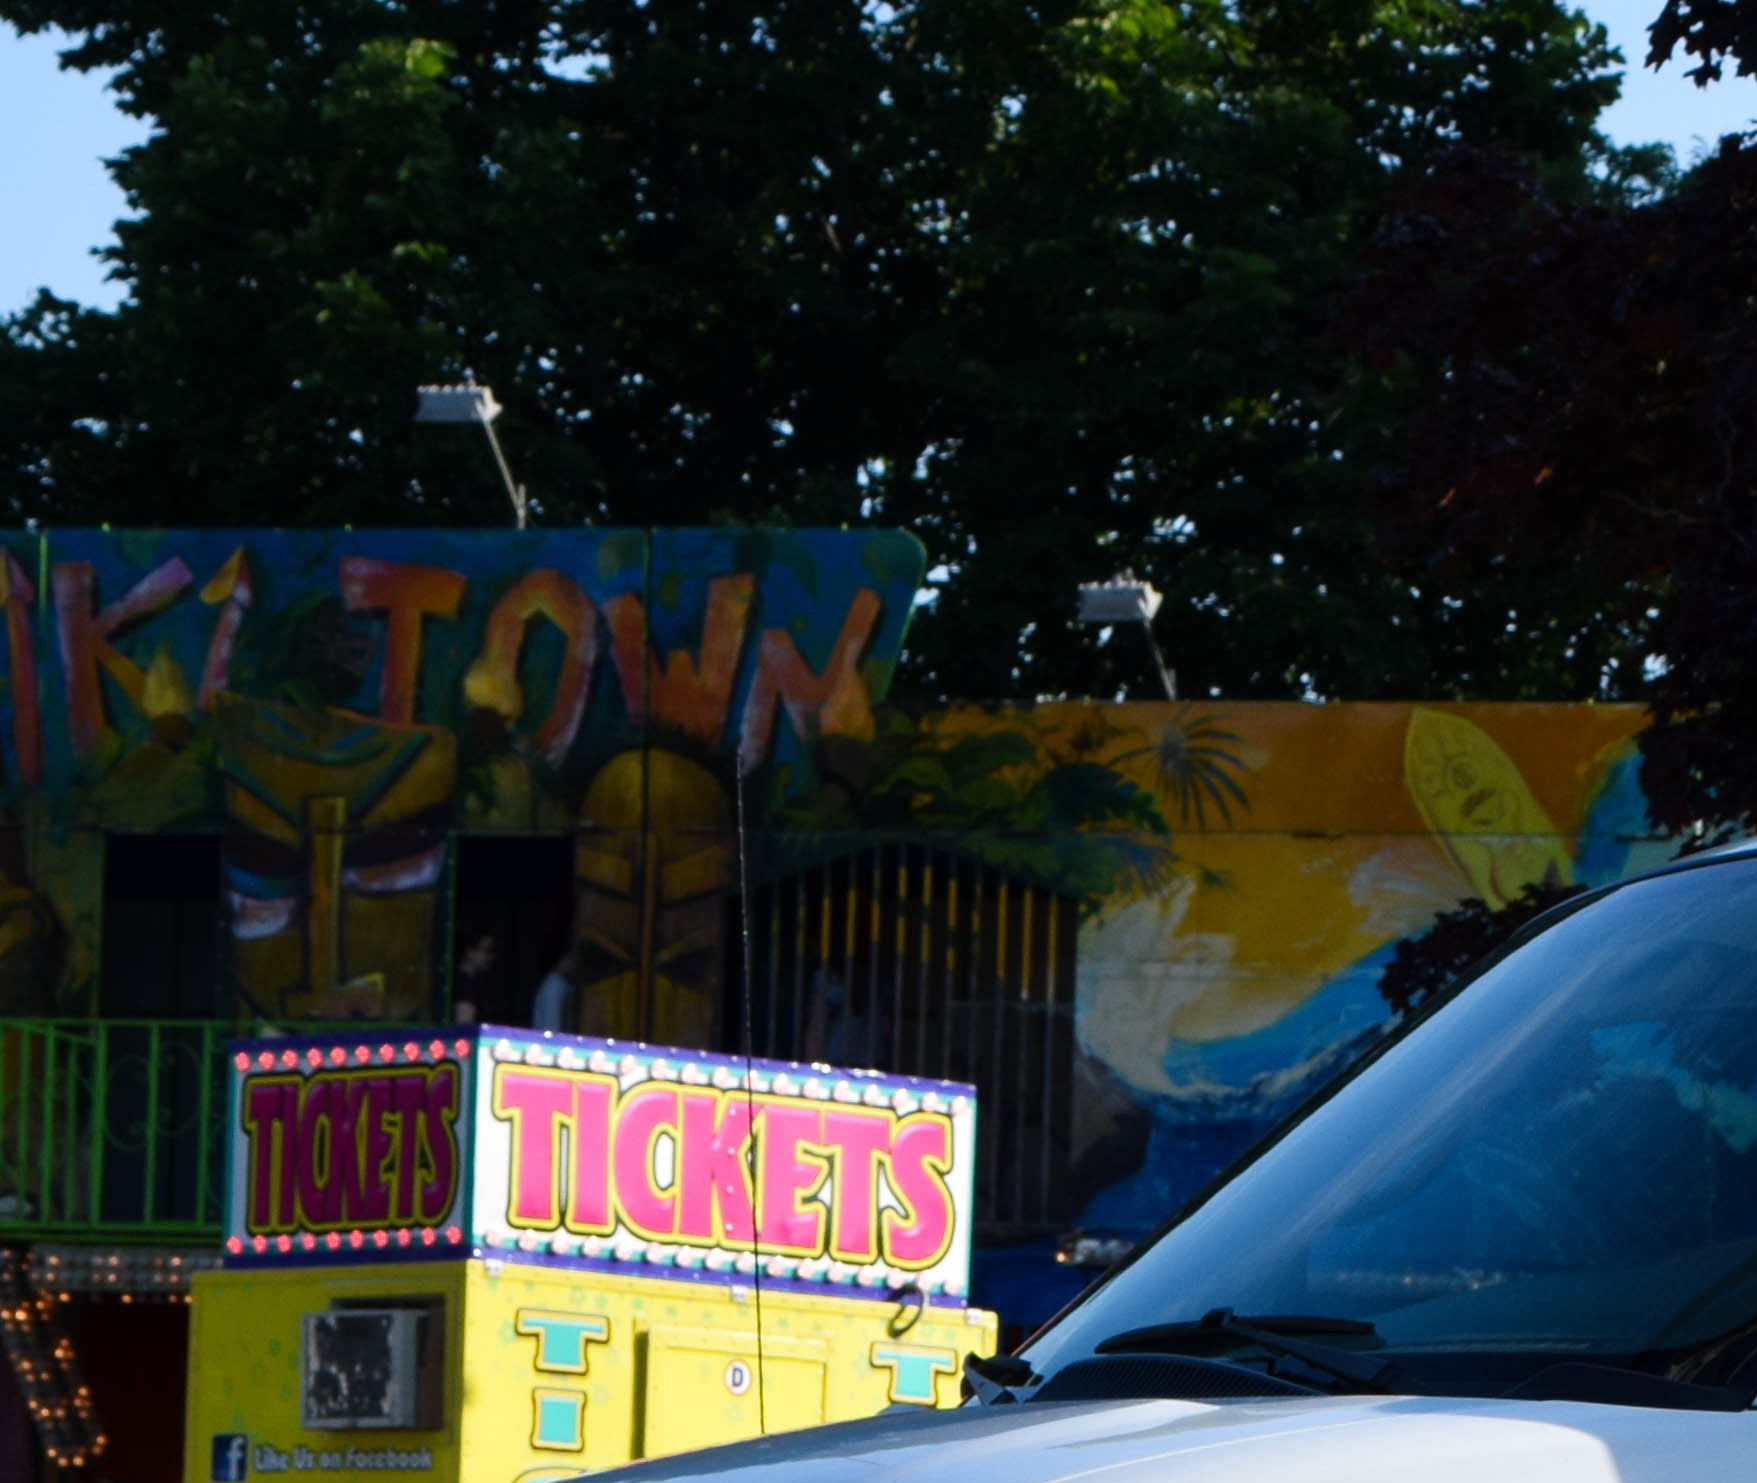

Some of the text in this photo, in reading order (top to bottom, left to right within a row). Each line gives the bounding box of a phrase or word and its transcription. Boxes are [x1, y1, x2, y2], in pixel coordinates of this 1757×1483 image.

[339, 556, 882, 776] TOWN
[246, 1067, 457, 1231] TICKETS
[496, 1068, 952, 1266] TICKETS
[254, 1445, 433, 1471] Like Us on Facebook
[731, 1365, 745, 1389] D
